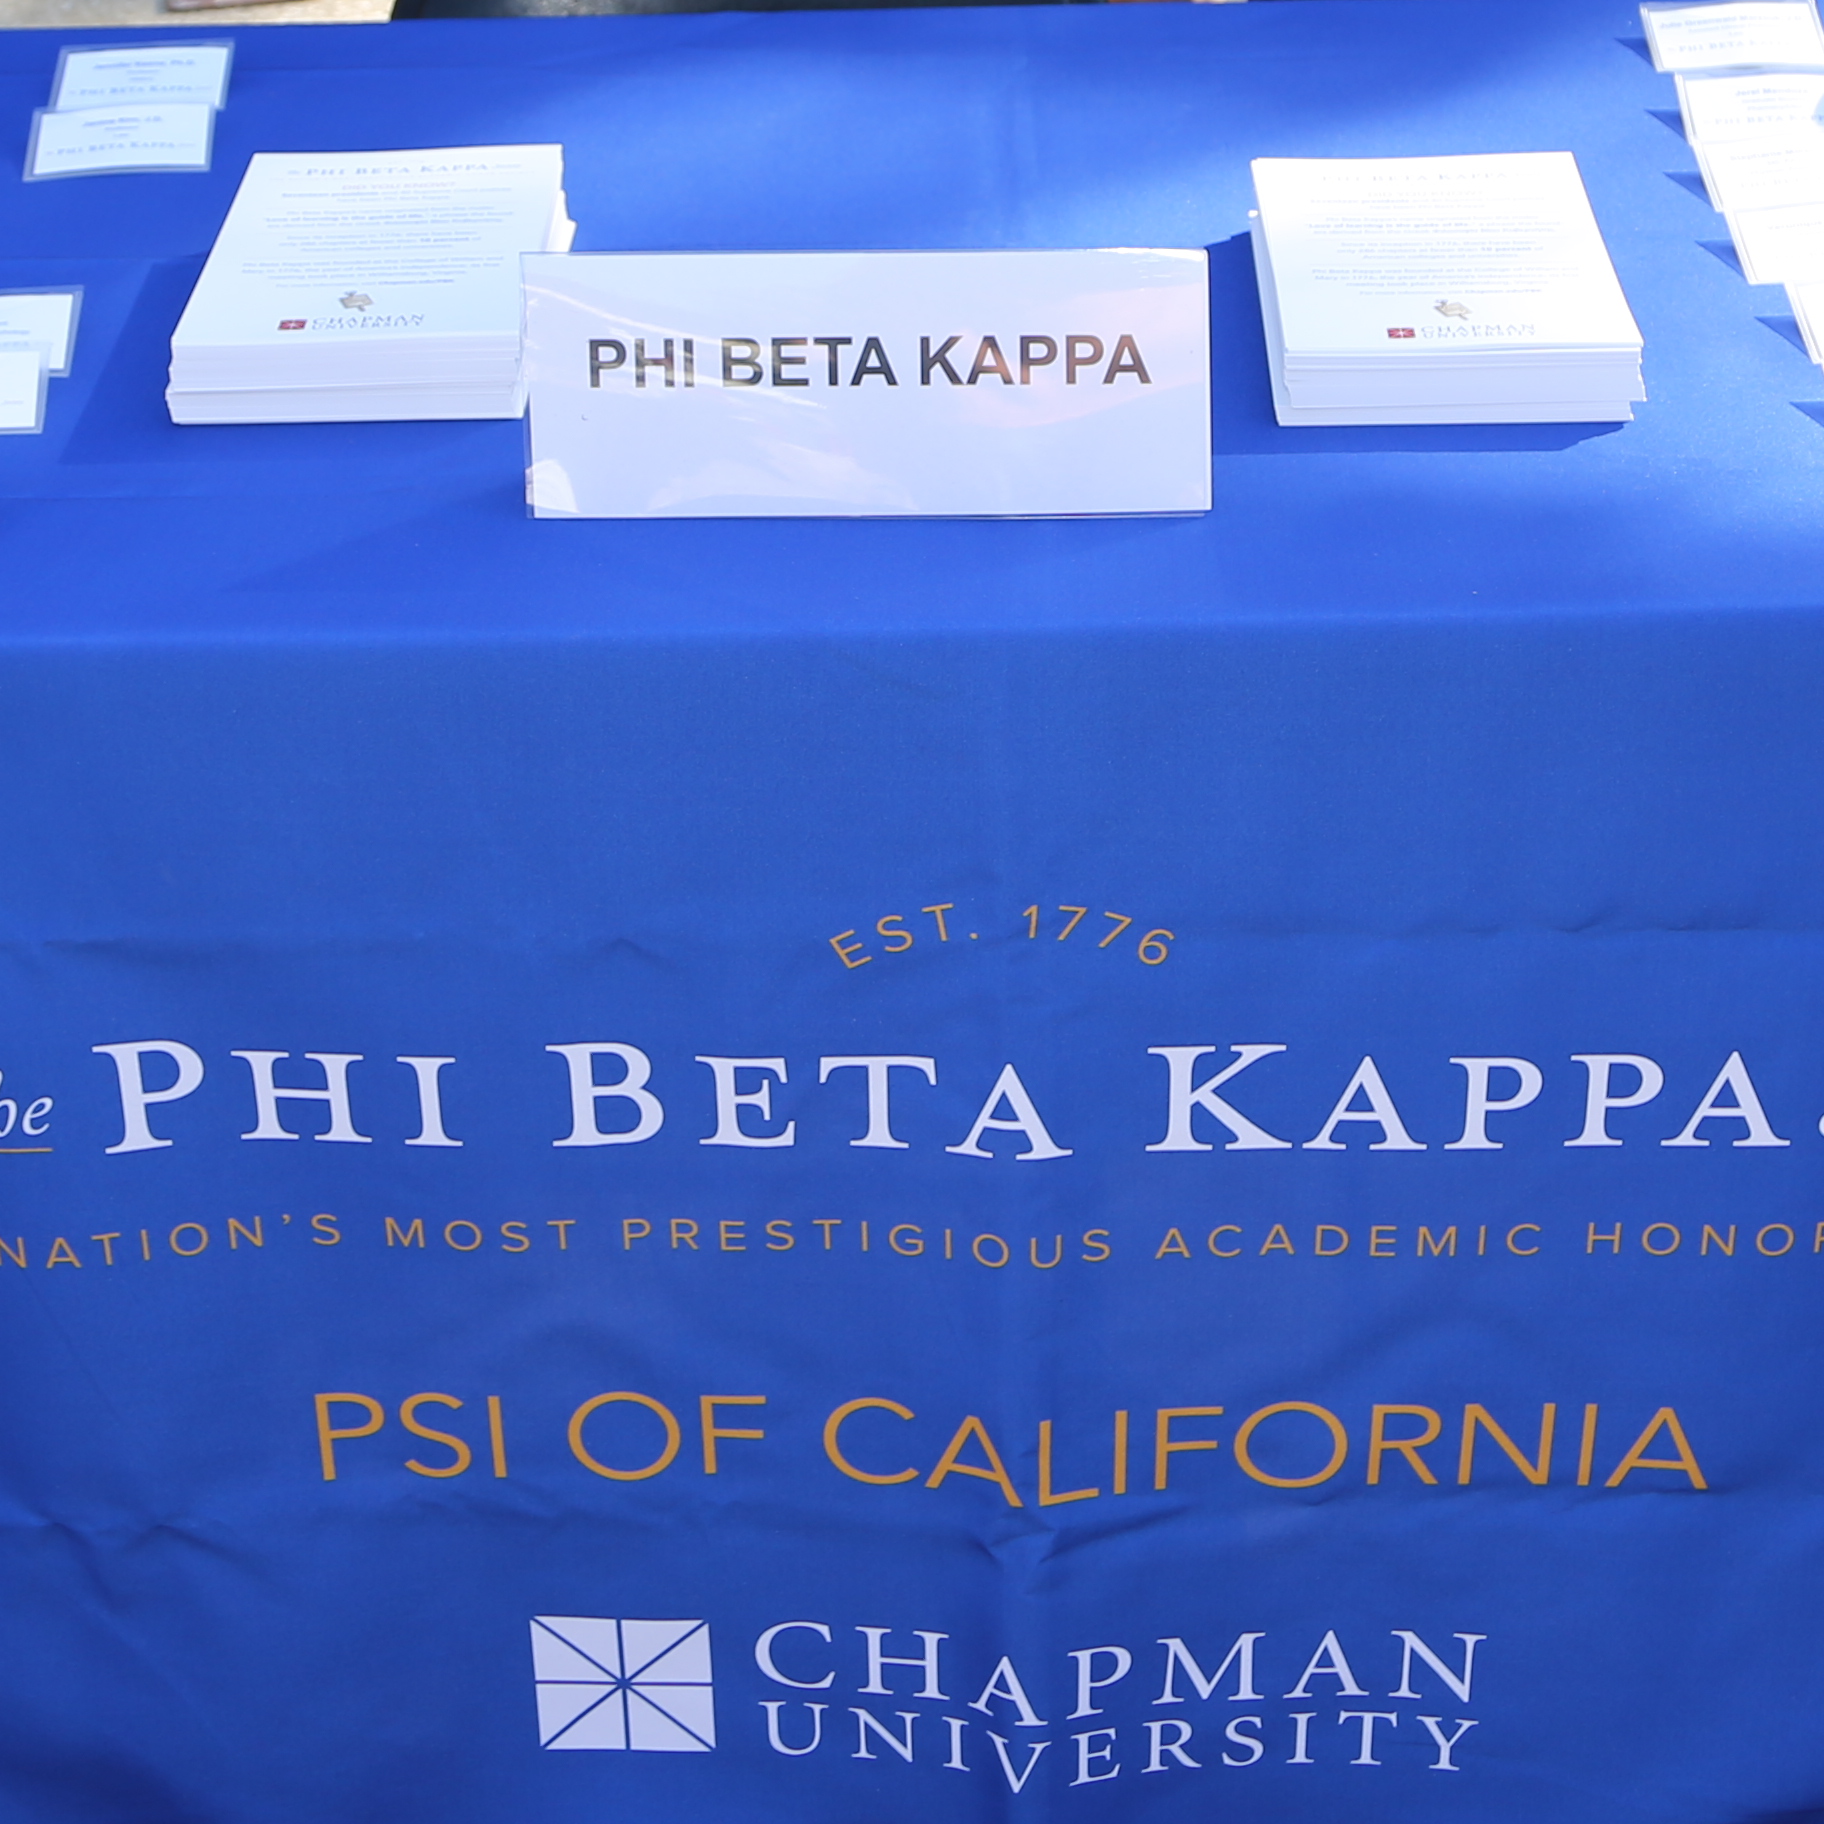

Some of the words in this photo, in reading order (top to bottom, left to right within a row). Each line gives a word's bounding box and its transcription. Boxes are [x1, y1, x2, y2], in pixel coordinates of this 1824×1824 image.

[588, 337, 694, 389] PHI
[721, 335, 899, 389] BETA
[919, 333, 1152, 387] KAPPA
[828, 902, 979, 970] EST.
[1020, 903, 1175, 966] 1776
[92, 1040, 465, 1155] PHI
[544, 1040, 1073, 1161] BETA
[1145, 1043, 1792, 1154] KAPPA
[382, 1214, 578, 1254] MOST
[620, 1216, 1113, 1271] PRESTIGIOUS
[1155, 1223, 1546, 1262] ACADEMIC
[313, 1391, 511, 1482] PSI
[565, 1390, 769, 1482] OF
[822, 1395, 1711, 1510] CALIFORNIA
[754, 1620, 1490, 1728] CHAPMAN
[758, 1698, 1484, 1795] UNIVERSITY
